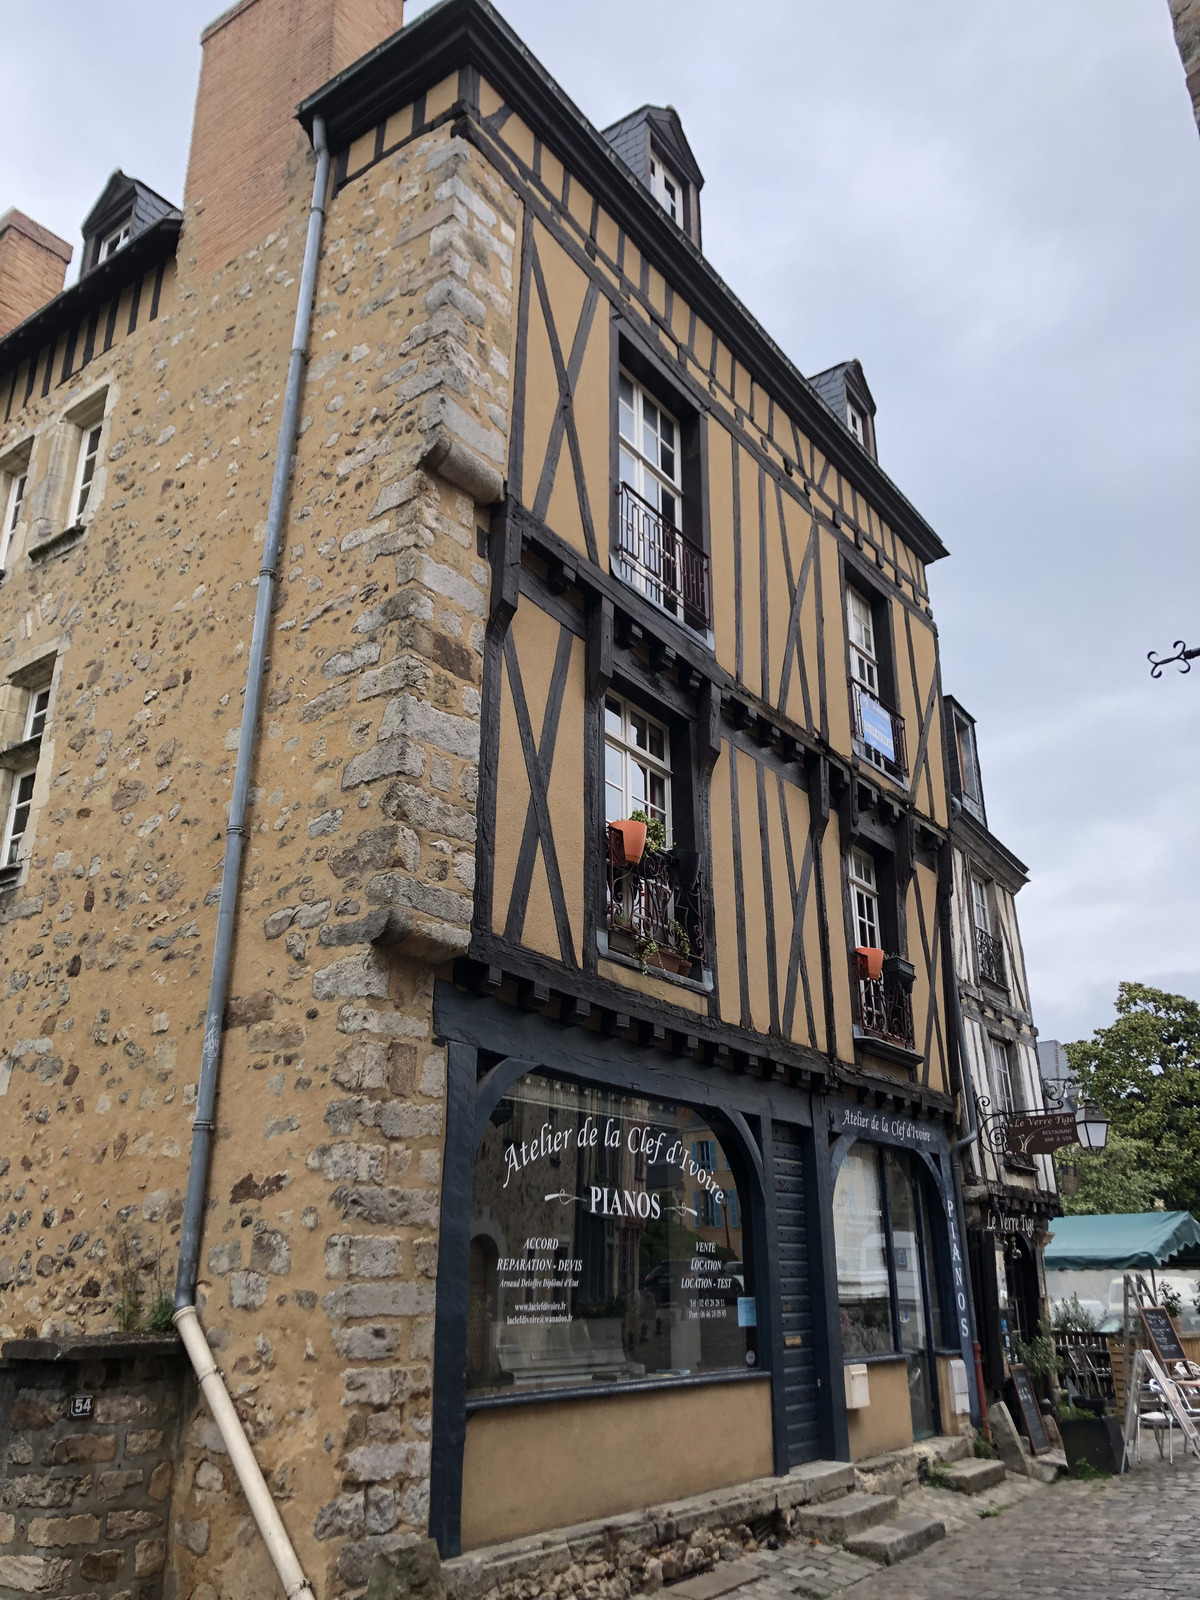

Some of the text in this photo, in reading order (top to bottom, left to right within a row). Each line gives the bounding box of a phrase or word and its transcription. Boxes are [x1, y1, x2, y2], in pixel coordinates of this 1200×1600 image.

[842, 1109, 931, 1142] Atelier de la Clef d'Ivoire
[1013, 1115, 1075, 1128] Le Verre Tige
[502, 1116, 725, 1205] Atelier de la Clef d'Ivoire
[589, 1185, 661, 1220] PIANOS
[986, 1208, 1035, 1239] Le Verre Tige
[523, 1237, 559, 1250] ACCORD
[695, 1241, 716, 1253] VENTE
[496, 1258, 552, 1271] REPARATION
[557, 1259, 583, 1271] DEVIS
[690, 1260, 722, 1270] LOCATION
[946, 1199, 968, 1337] PIANOS
[681, 1278, 712, 1289] LOCATION
[717, 1278, 732, 1289] TEST
[75, 1398, 92, 1413] 54
